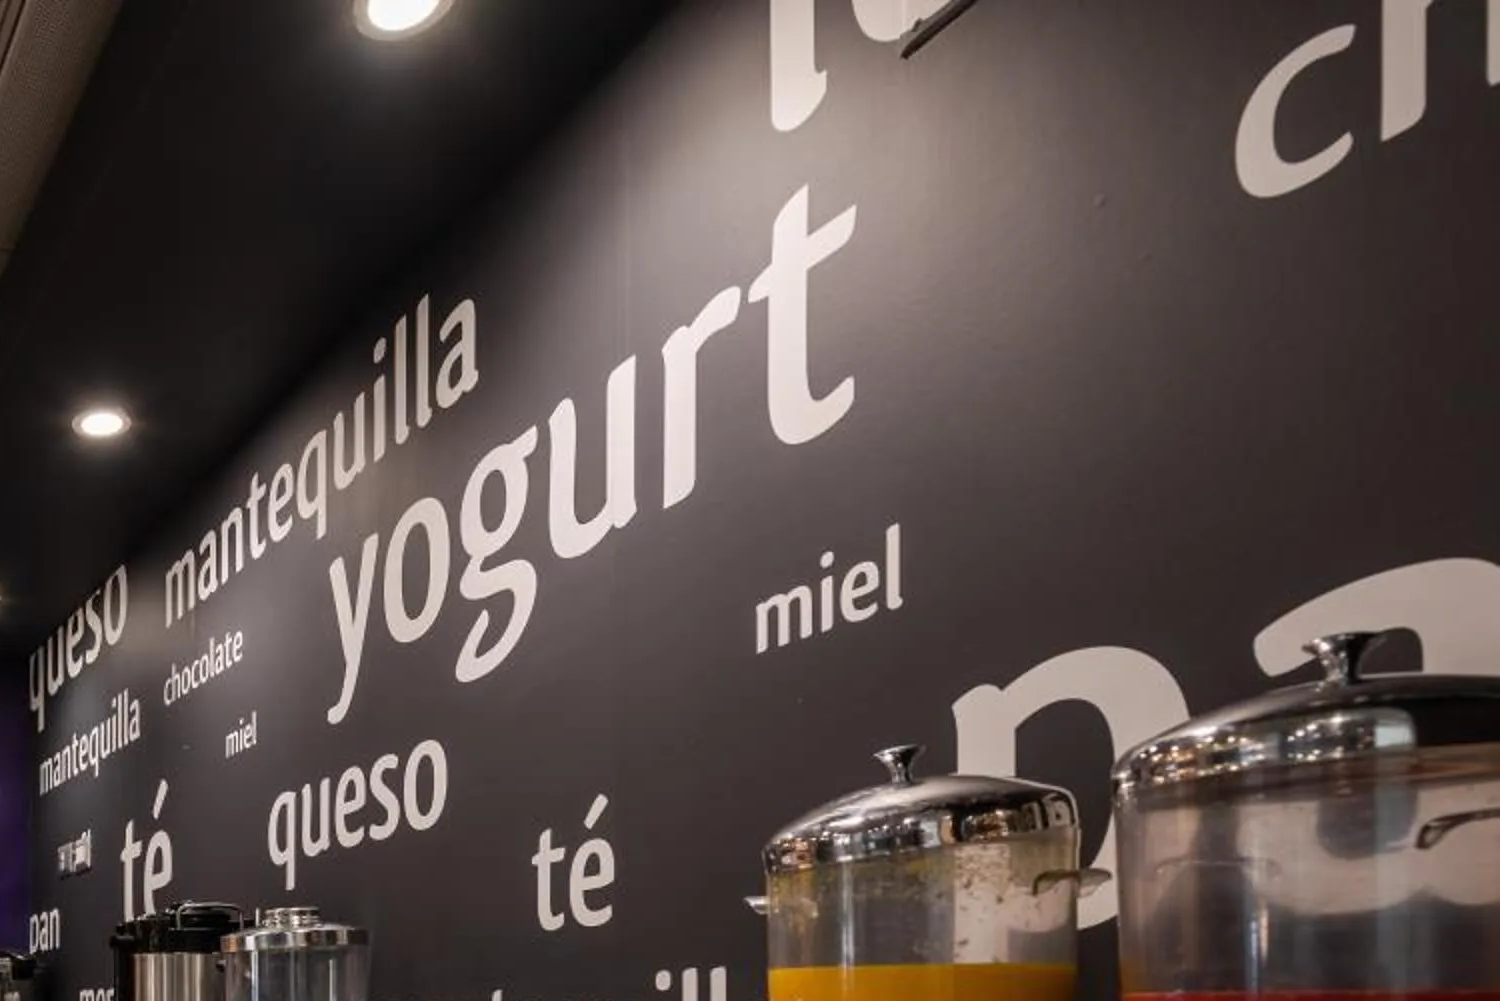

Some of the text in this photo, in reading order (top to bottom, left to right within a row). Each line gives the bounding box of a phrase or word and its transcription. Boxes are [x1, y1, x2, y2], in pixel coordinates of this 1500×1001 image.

[165, 294, 479, 627] mantequilla
[327, 184, 856, 724] yogurt
[29, 565, 128, 731] queso
[756, 523, 903, 653] miel
[164, 630, 243, 705] chocolate
[226, 711, 257, 758] miel
[40, 689, 140, 795] mantequilla
[121, 780, 173, 922] té
[268, 740, 448, 890] queso
[532, 794, 615, 930] té
[29, 907, 60, 954] pan
